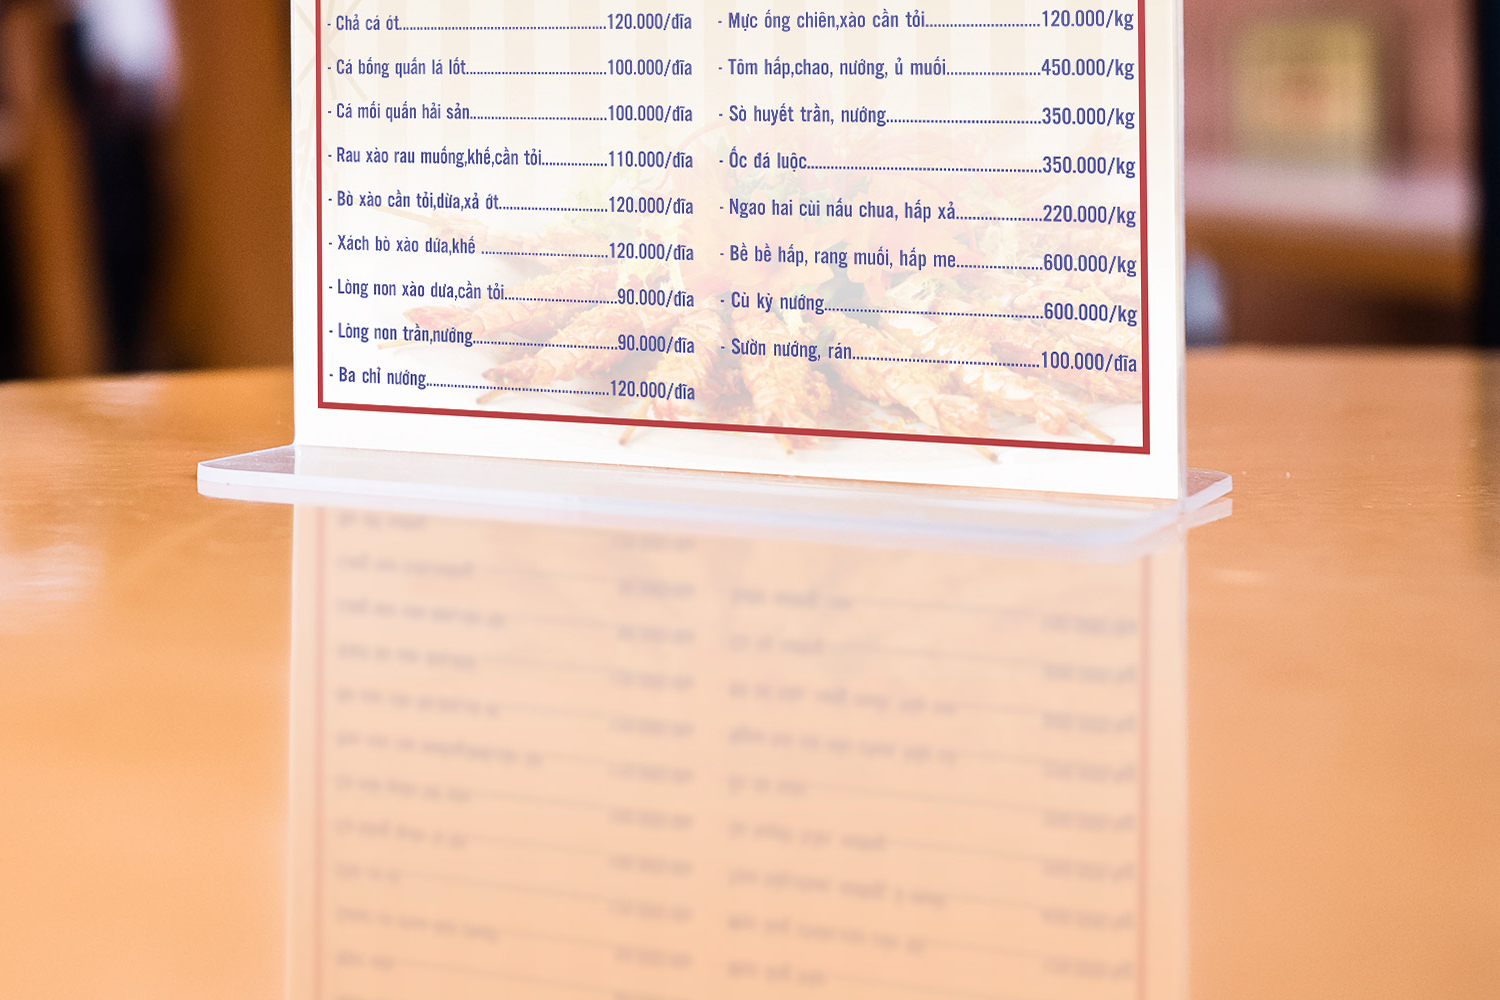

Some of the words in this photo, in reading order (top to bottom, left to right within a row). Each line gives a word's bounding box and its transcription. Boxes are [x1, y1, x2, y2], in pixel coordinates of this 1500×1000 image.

[335, 58, 353, 75] Cá
[357, 56, 390, 79] bống
[394, 56, 426, 79] quấn
[431, 58, 443, 75] lá
[448, 56, 466, 75] lốt
[607, 58, 692, 77] 100.000/đĩa
[336, 102, 353, 119] Cá
[357, 100, 381, 119] mối
[385, 100, 417, 123] quấn
[421, 101, 441, 119] hải
[445, 101, 470, 120] sản
[607, 104, 693, 123] 100.000/đĩa
[728, 145, 747, 168] Ốc
[753, 151, 770, 169] đá
[777, 151, 807, 172] luộc
[1042, 155, 1136, 179] 350.000/kg
[729, 197, 766, 219] Ngao
[771, 198, 793, 216] hai
[798, 199, 820, 217] cùi
[825, 197, 853, 217] nấu
[858, 200, 898, 221] chua,
[904, 198, 931, 223] hấp
[937, 200, 955, 220] xả
[1043, 204, 1136, 228] 220.000/kg
[729, 242, 748, 262] Bề
[754, 242, 772, 263] bề
[777, 243, 808, 267] hấp,
[814, 250, 848, 269] rang
[853, 245, 893, 269] muối,
[899, 246, 927, 271] hấp
[933, 253, 956, 268] me
[1043, 253, 1137, 278] 600.000/kg
[730, 290, 750, 308] Cù
[756, 291, 773, 313] kỳ
[779, 293, 825, 315] nướng
[1044, 301, 1138, 327] 600.000/kg
[338, 365, 356, 383] Ba
[361, 366, 381, 384] chỉ
[386, 369, 427, 390] nướng
[609, 379, 695, 401] 120.000/đĩa
